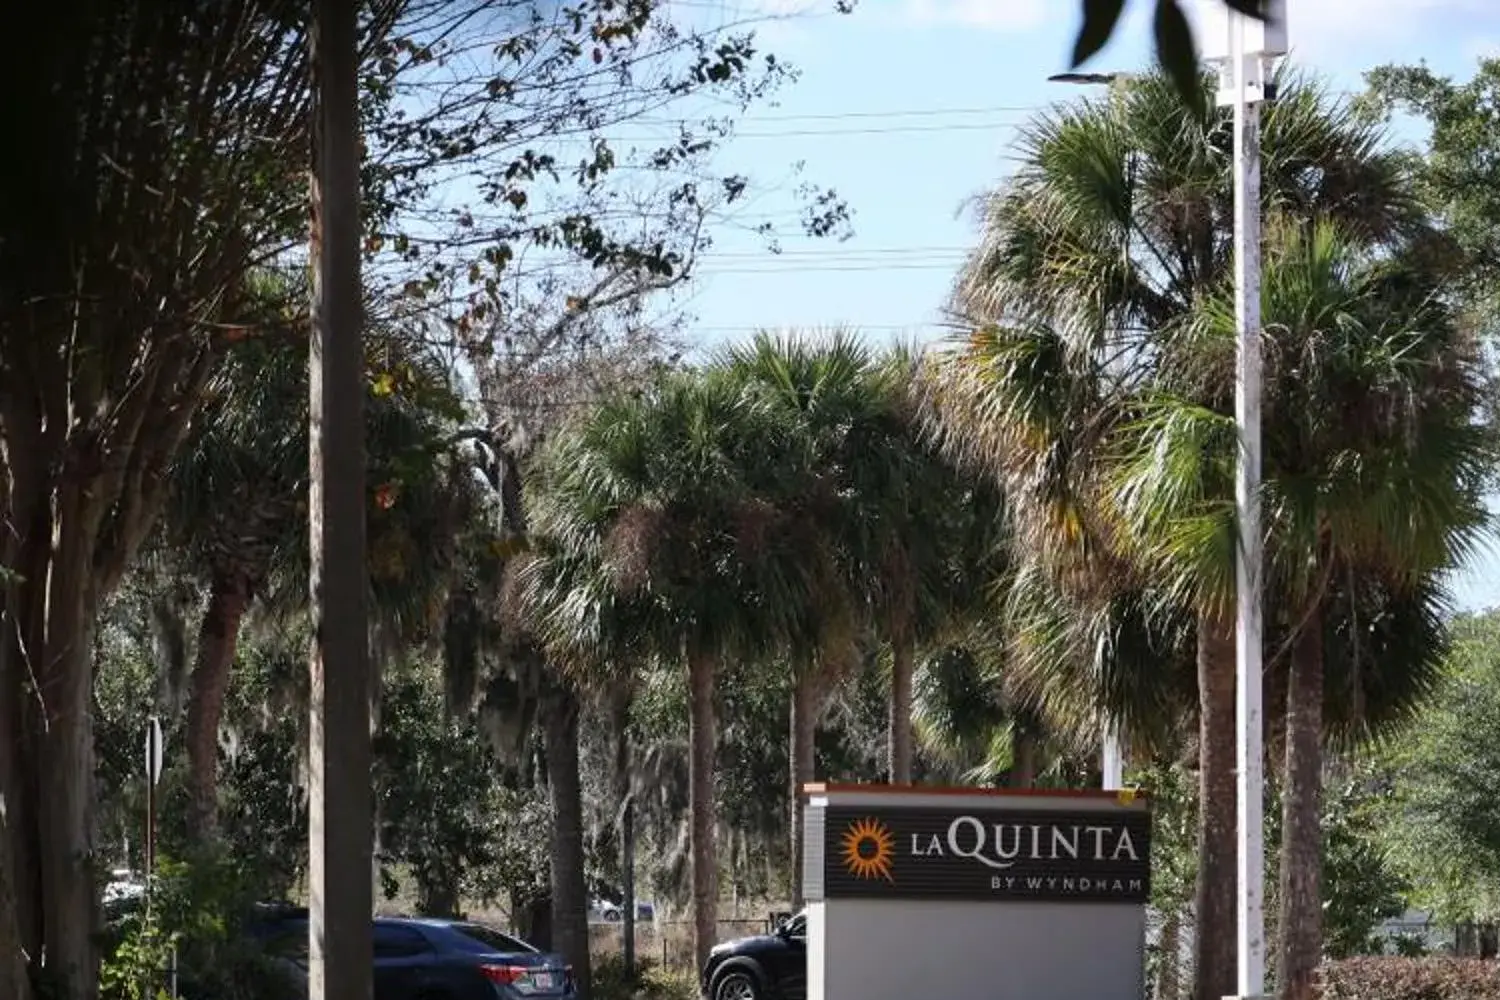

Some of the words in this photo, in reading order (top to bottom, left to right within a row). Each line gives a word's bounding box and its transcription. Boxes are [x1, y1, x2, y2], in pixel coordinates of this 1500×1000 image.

[911, 833, 944, 856] LA
[947, 815, 1139, 868] QUINTA
[991, 876, 1014, 889] BY
[1026, 876, 1142, 891] WYNDHAM
